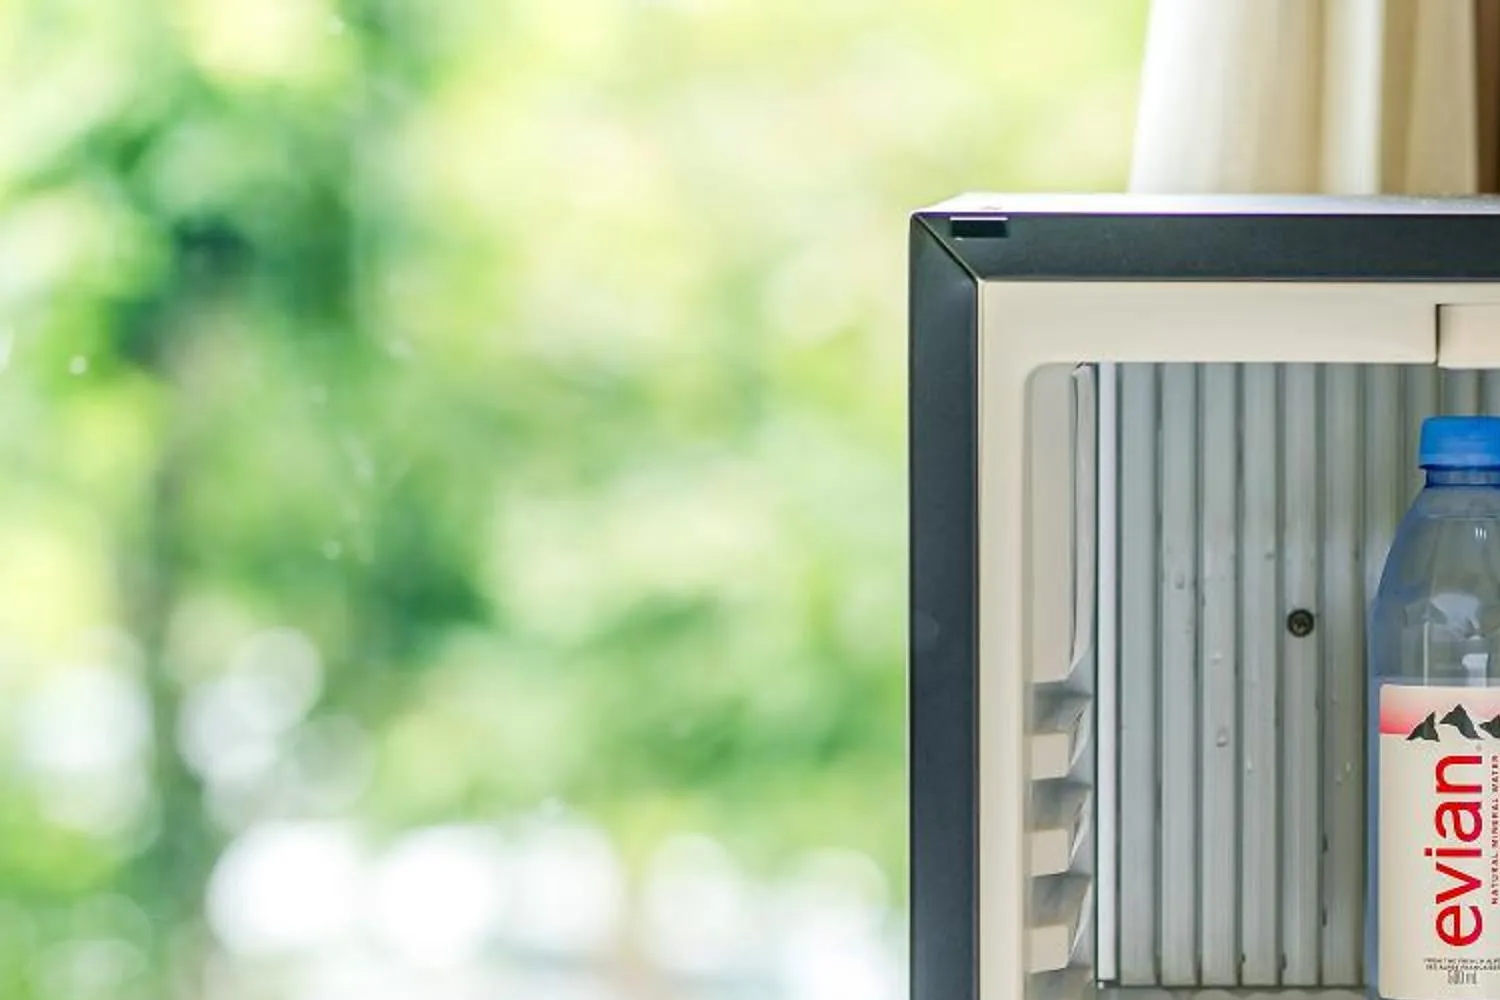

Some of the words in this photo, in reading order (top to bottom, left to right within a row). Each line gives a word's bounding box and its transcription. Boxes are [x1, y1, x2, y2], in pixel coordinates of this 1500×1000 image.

[1490, 755, 1499, 793] WATER
[1490, 798, 1499, 849] MINERAL
[1424, 755, 1483, 947] evian
[1490, 853, 1499, 905] NATURAL
